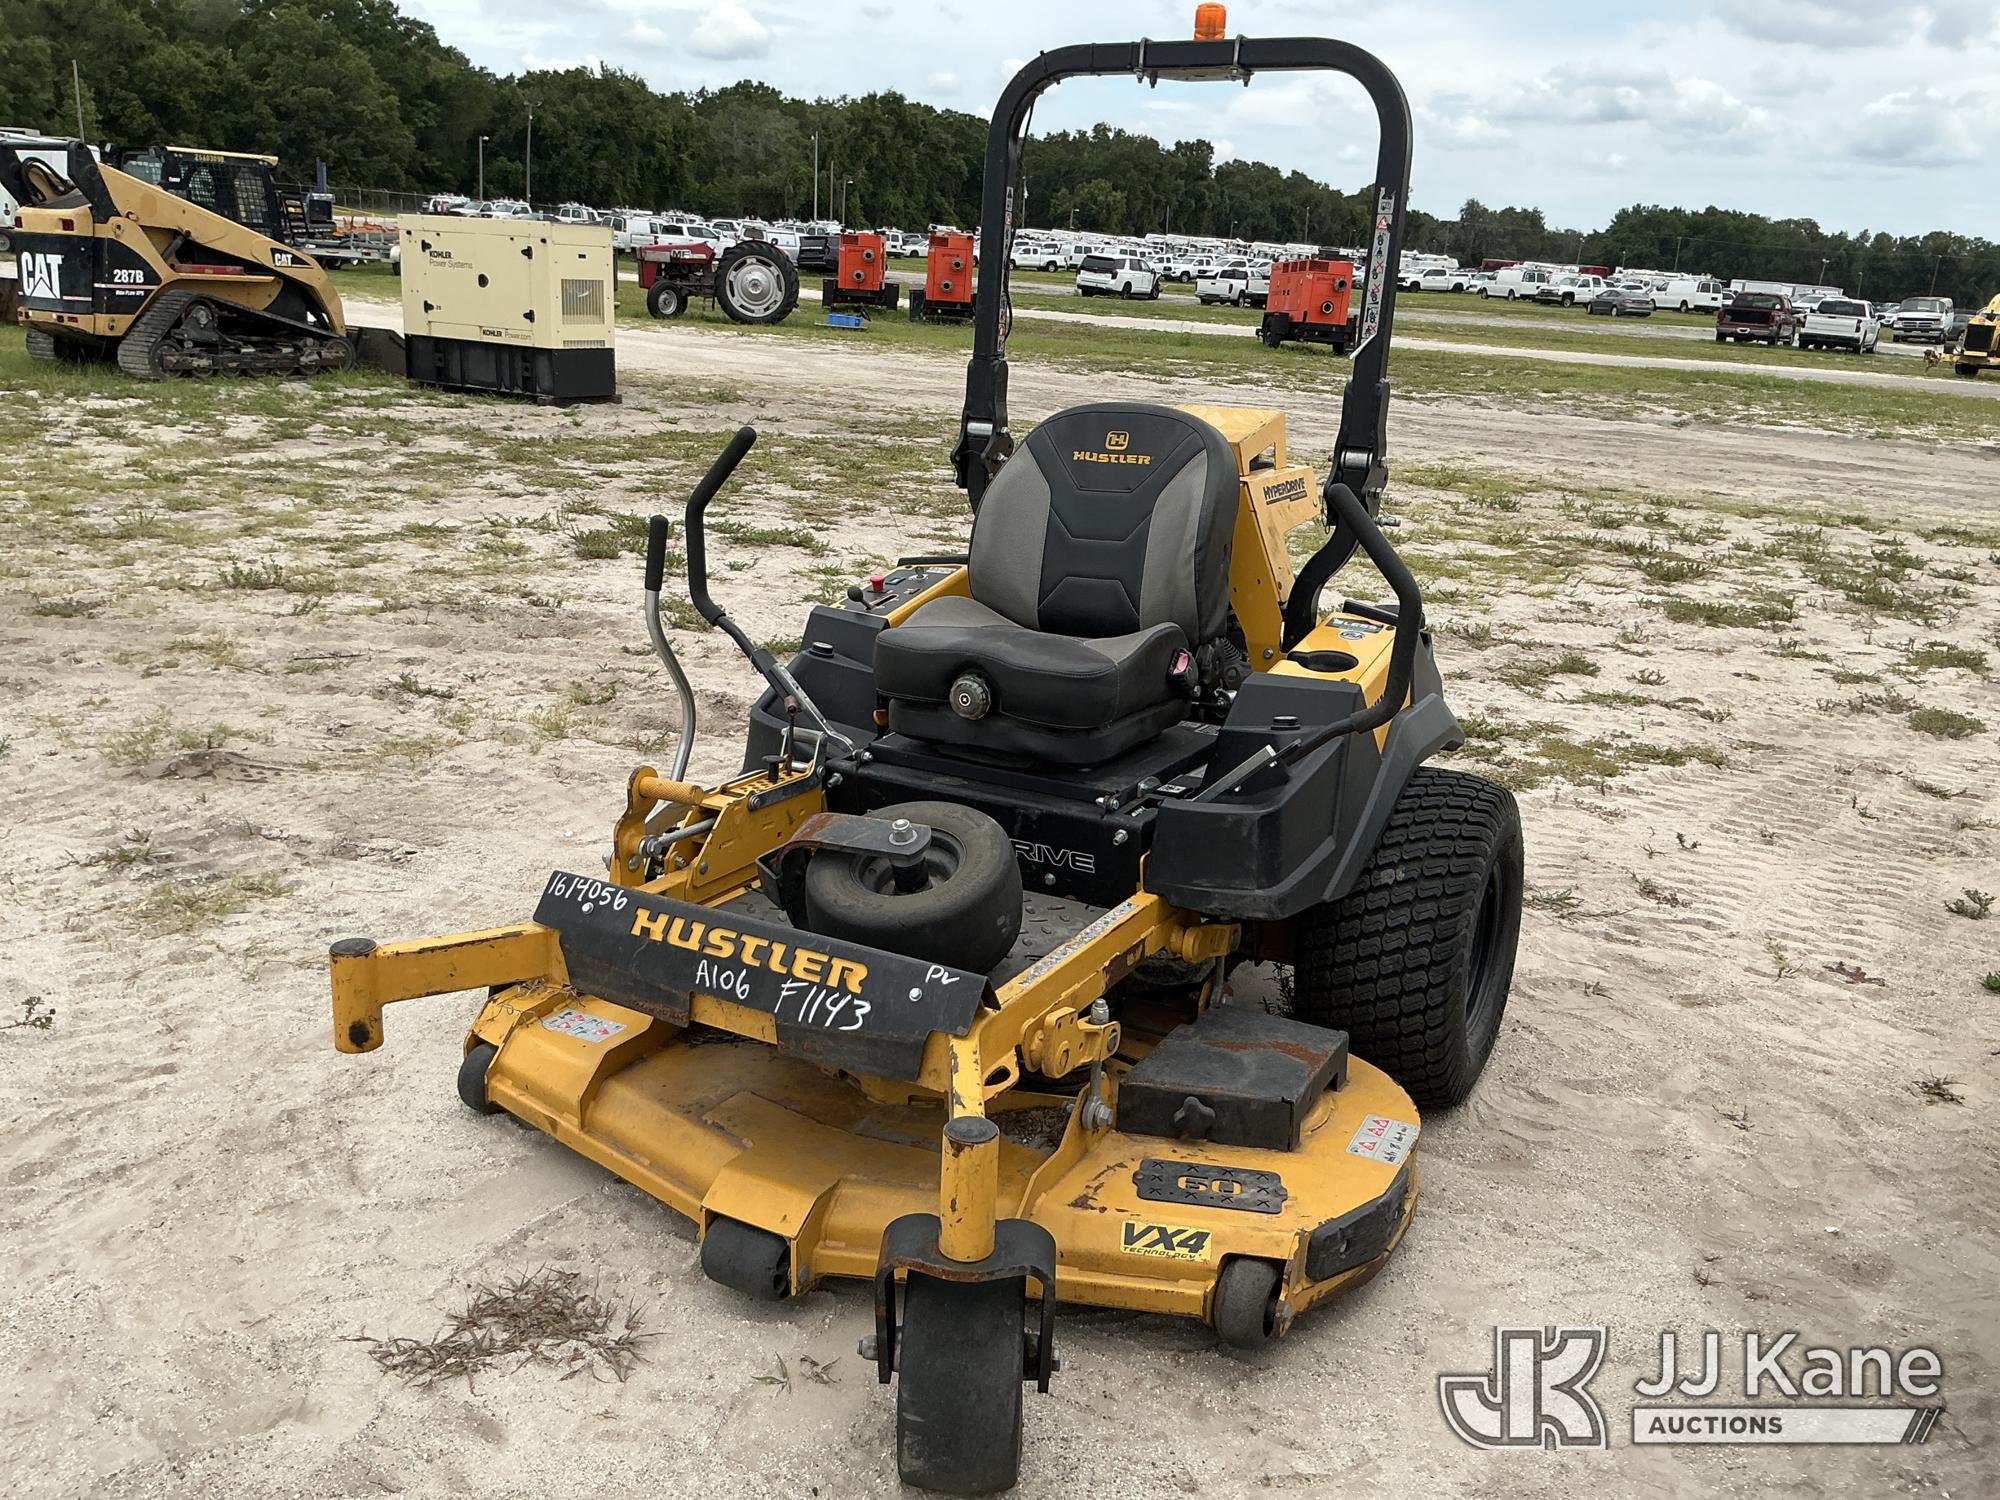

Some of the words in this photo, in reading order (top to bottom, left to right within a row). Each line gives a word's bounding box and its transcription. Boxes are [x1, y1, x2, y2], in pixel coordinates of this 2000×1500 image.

[274, 253, 292, 266] CAT
[429, 250, 453, 259] KOHLER
[430, 259, 446, 267] Power
[448, 260, 473, 269] Systems
[21, 251, 64, 299] CAT
[113, 269, 144, 283] 287B
[482, 329, 503, 338] KOHLER
[1073, 451, 1151, 465] HUSTLER
[548, 873, 628, 911] 1614056
[630, 906, 868, 995] HUSTLER
[695, 959, 750, 1000] A106
[773, 977, 871, 1031] F1143
[1176, 1175, 1243, 1195] 60
[1124, 1222, 1210, 1254] VX4
